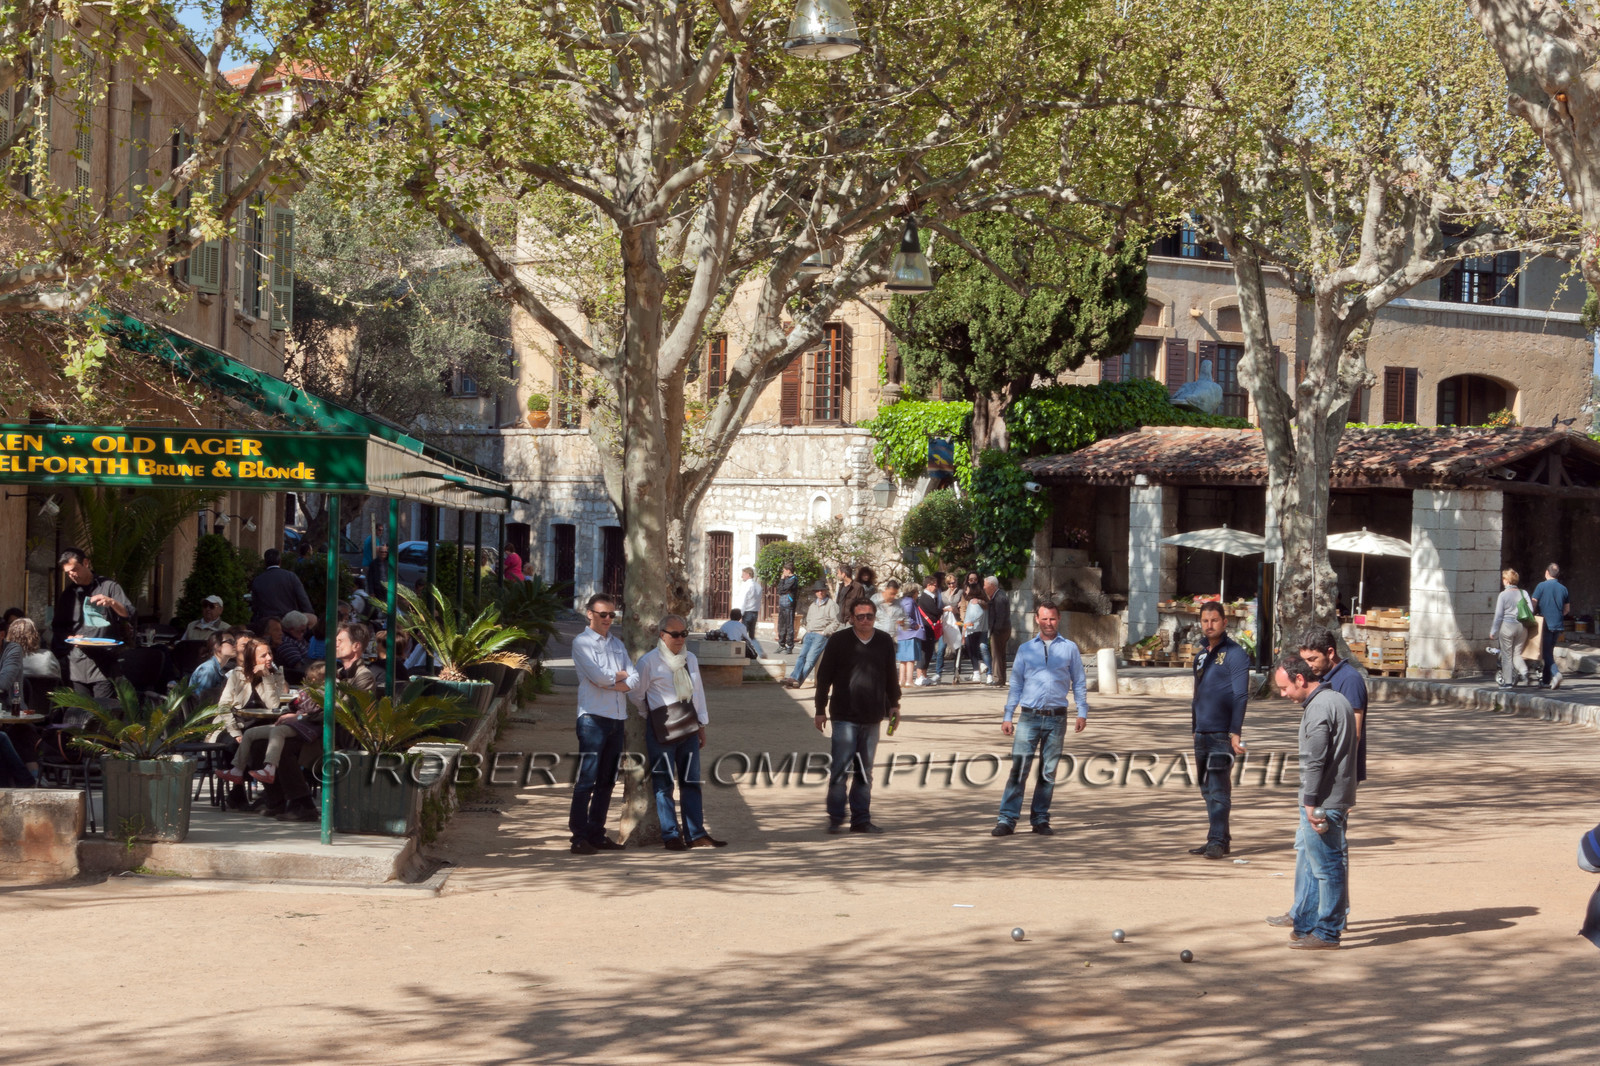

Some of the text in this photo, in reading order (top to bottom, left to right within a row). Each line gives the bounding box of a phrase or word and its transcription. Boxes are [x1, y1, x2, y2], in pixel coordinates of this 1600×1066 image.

[92, 435, 156, 453] OLD
[164, 437, 263, 456] LAGER
[211, 460, 232, 477] &
